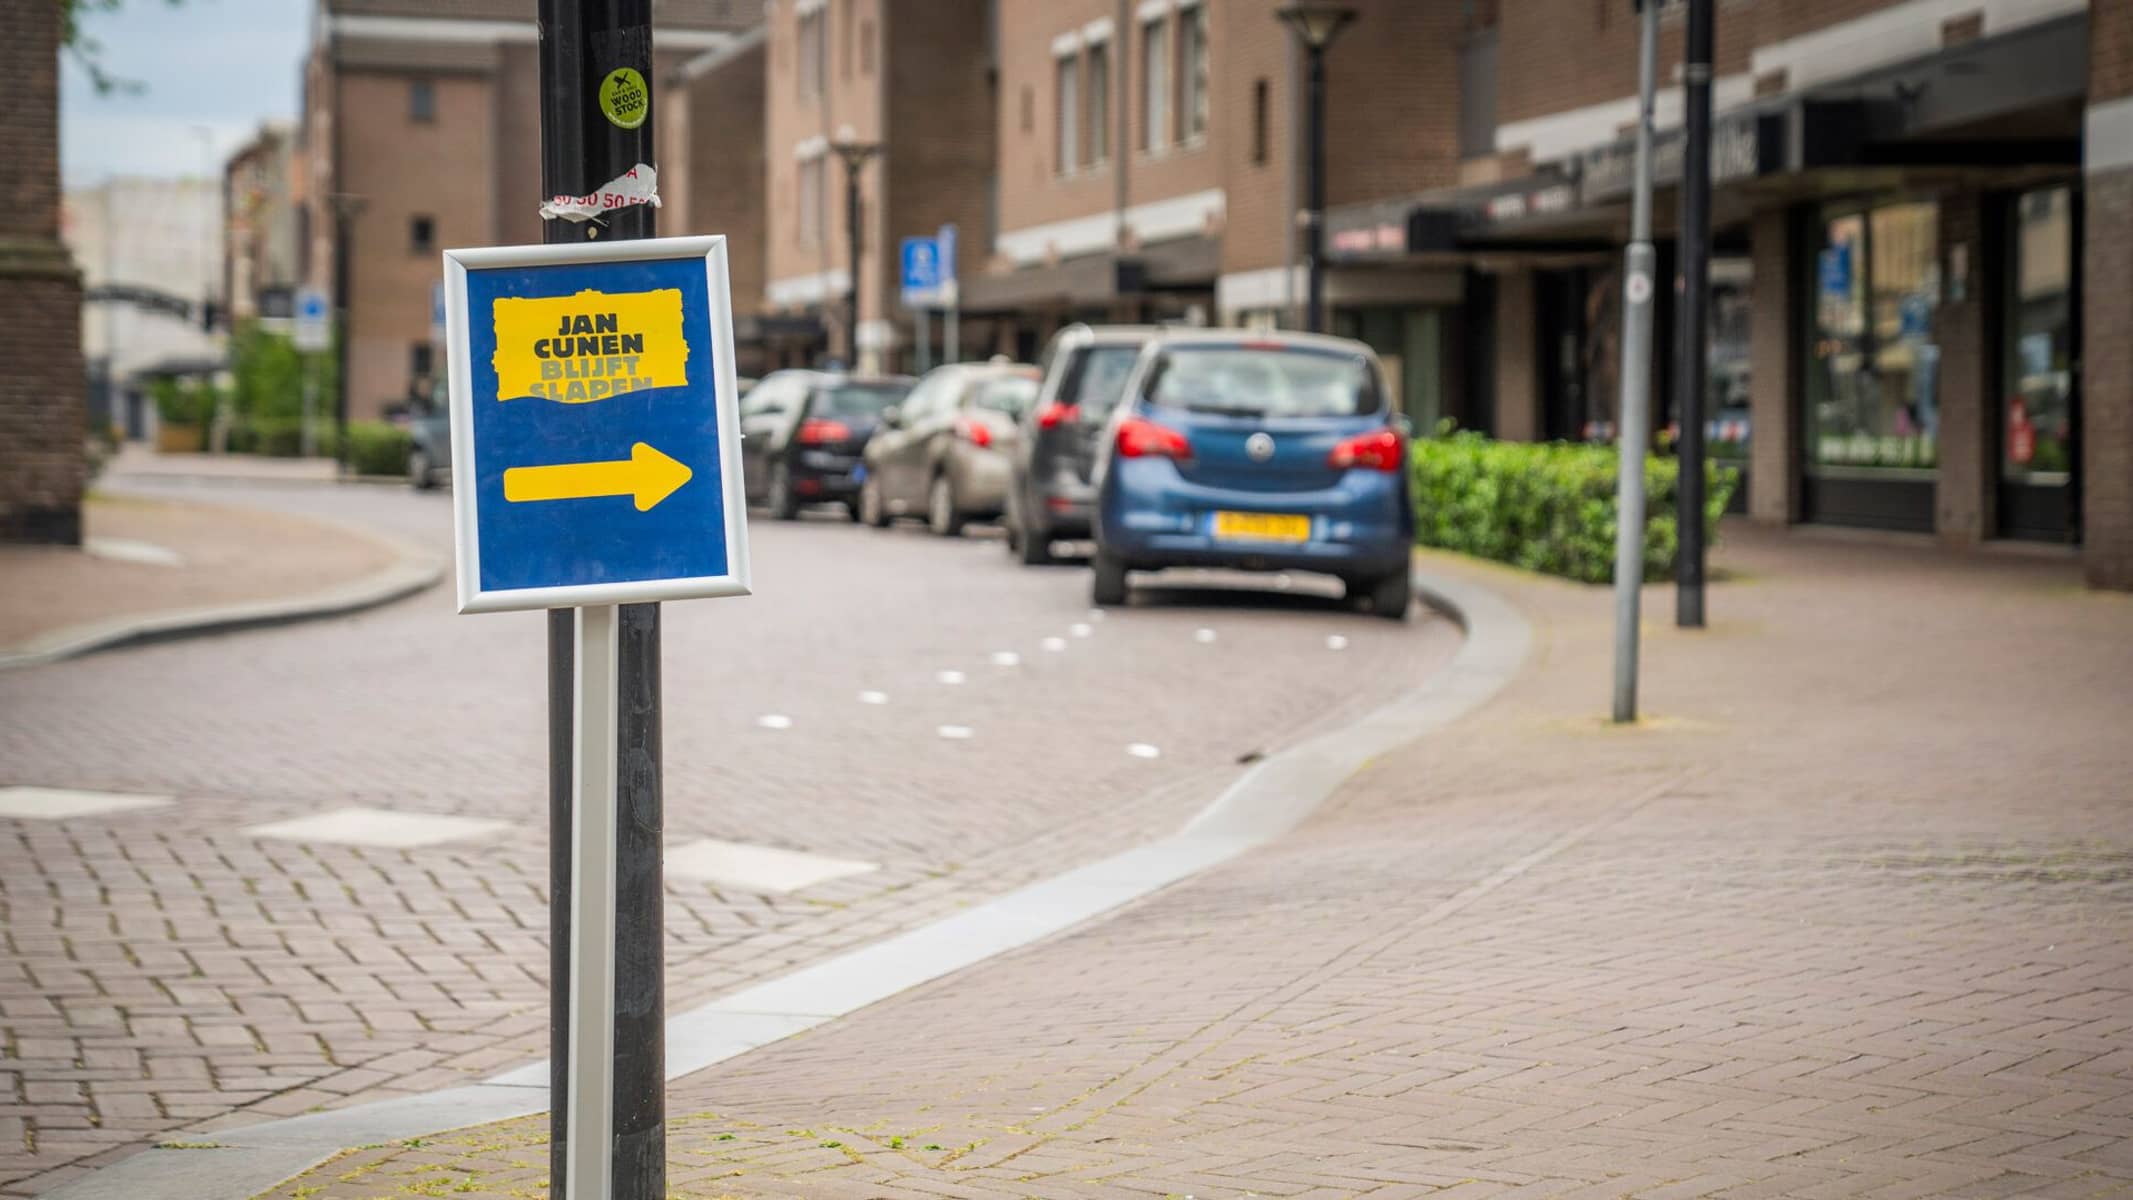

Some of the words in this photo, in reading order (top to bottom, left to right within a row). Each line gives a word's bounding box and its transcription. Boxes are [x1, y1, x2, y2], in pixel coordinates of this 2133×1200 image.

[610, 89, 642, 106] WOOD
[615, 100, 644, 116] STOCK
[603, 193, 625, 208] 50
[558, 313, 618, 336] JAN
[534, 334, 644, 358] CUNEN
[541, 355, 641, 380] BLIJFT
[529, 377, 653, 401] SLAPEN
